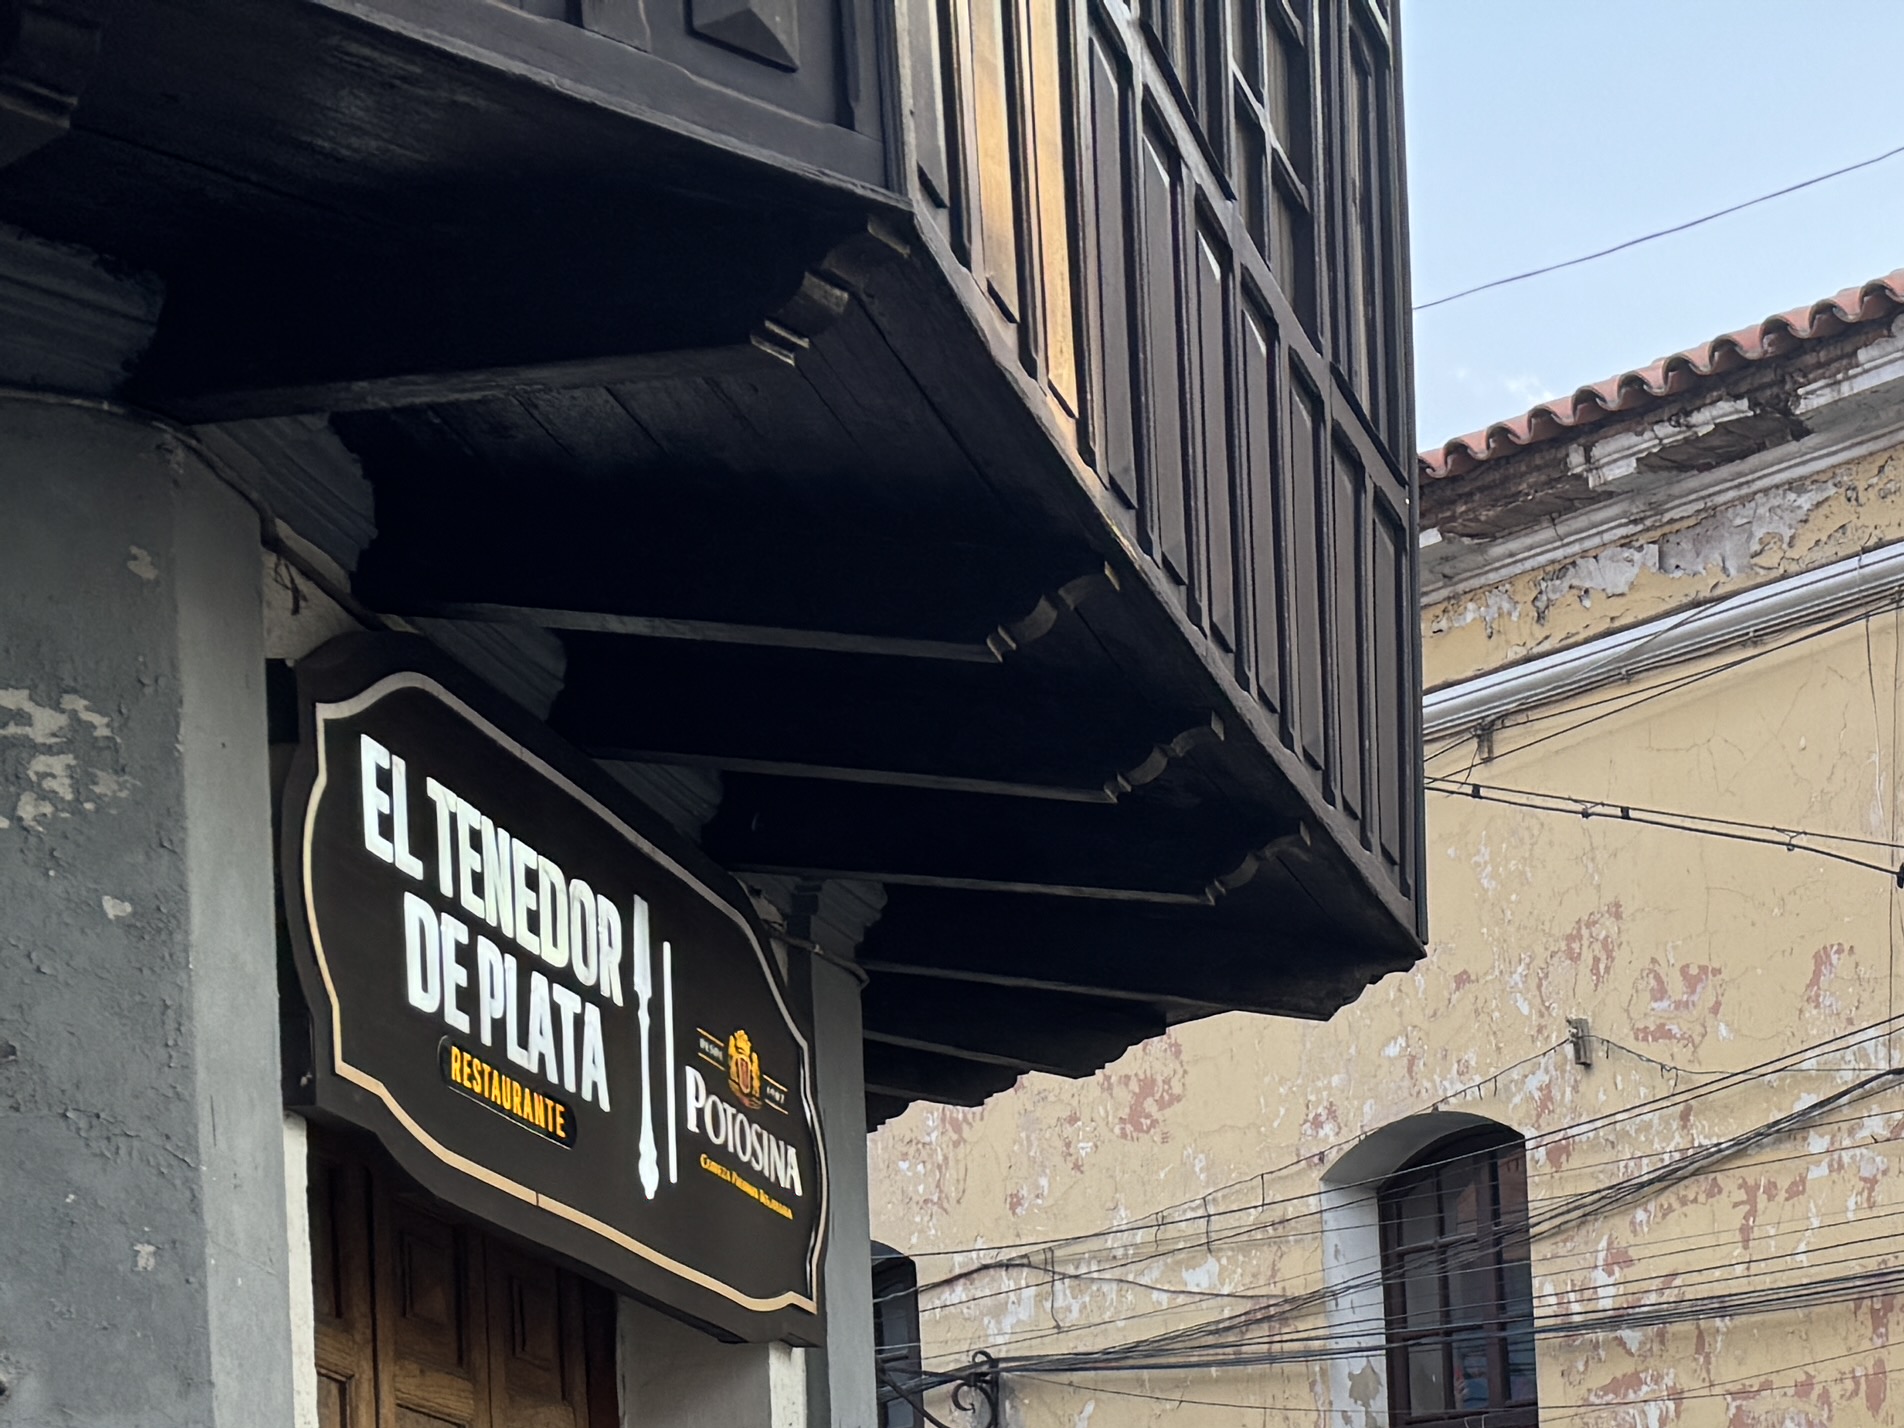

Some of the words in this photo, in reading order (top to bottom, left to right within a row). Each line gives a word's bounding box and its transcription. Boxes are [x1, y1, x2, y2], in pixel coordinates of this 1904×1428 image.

[360, 733, 424, 880] EL
[427, 776, 624, 1007] TENEDOR
[404, 891, 470, 1034] DE
[477, 934, 611, 1113] PLATA
[450, 1045, 567, 1140] RESTAURANTE
[685, 1065, 803, 1197] POTOSINA
